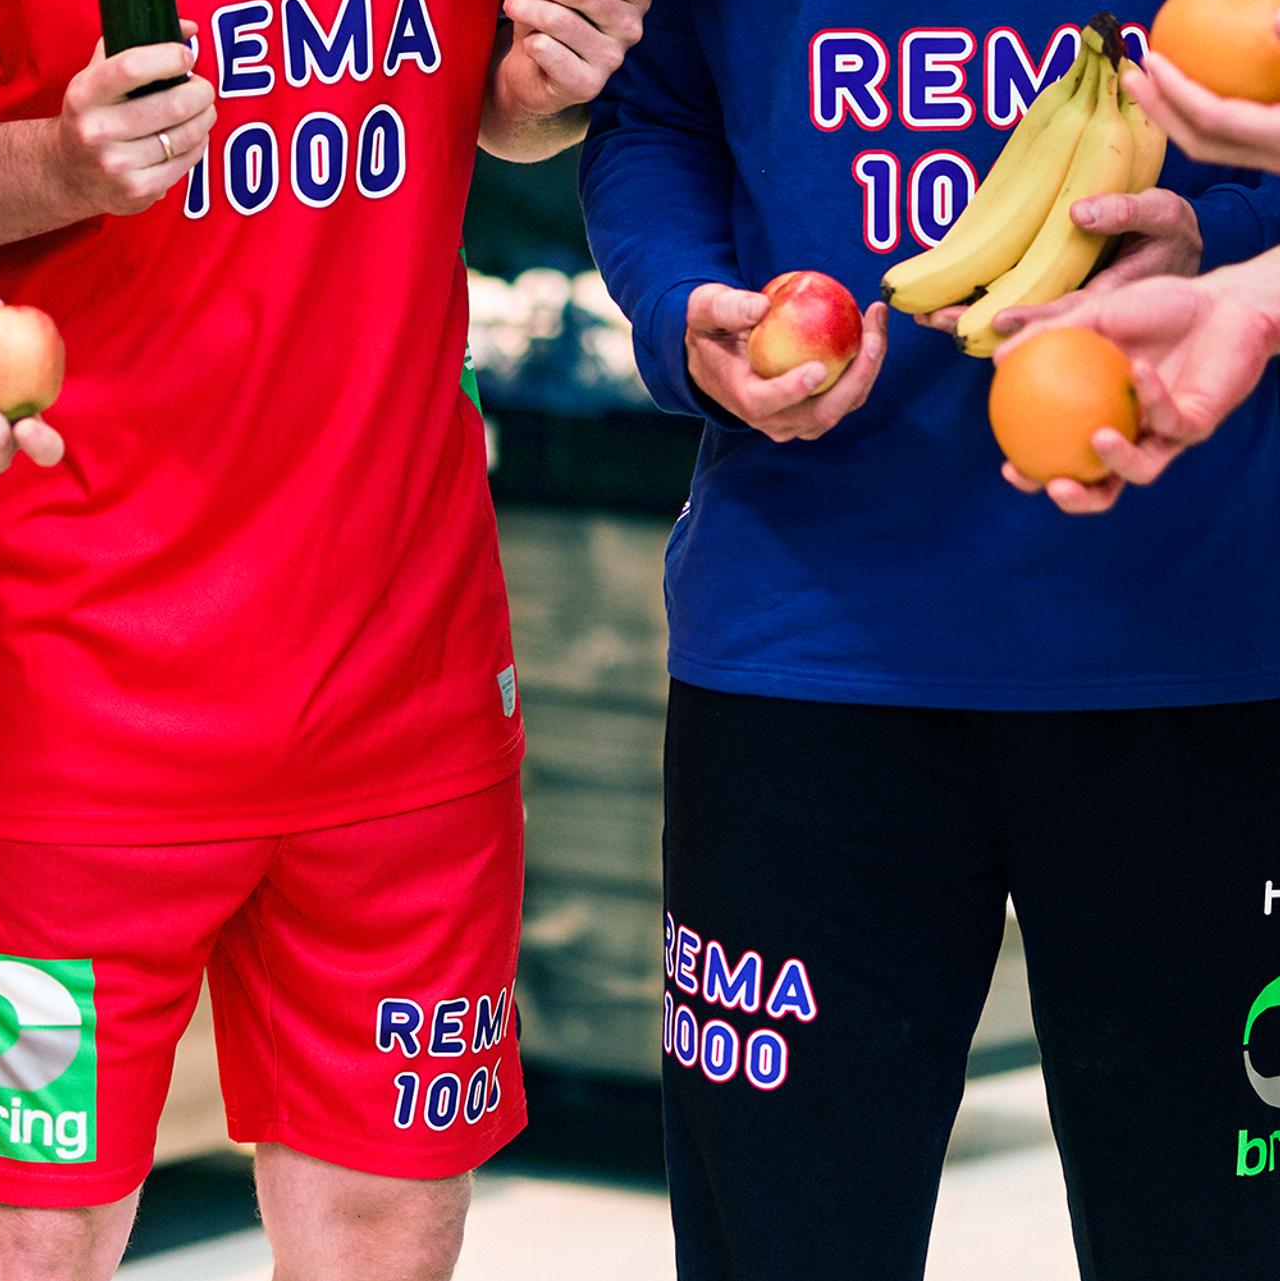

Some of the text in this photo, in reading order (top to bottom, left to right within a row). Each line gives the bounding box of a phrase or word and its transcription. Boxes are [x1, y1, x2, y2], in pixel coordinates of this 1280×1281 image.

[809, 22, 1150, 132] REM
[851, 148, 979, 254] 10
[376, 978, 516, 1058] REM
